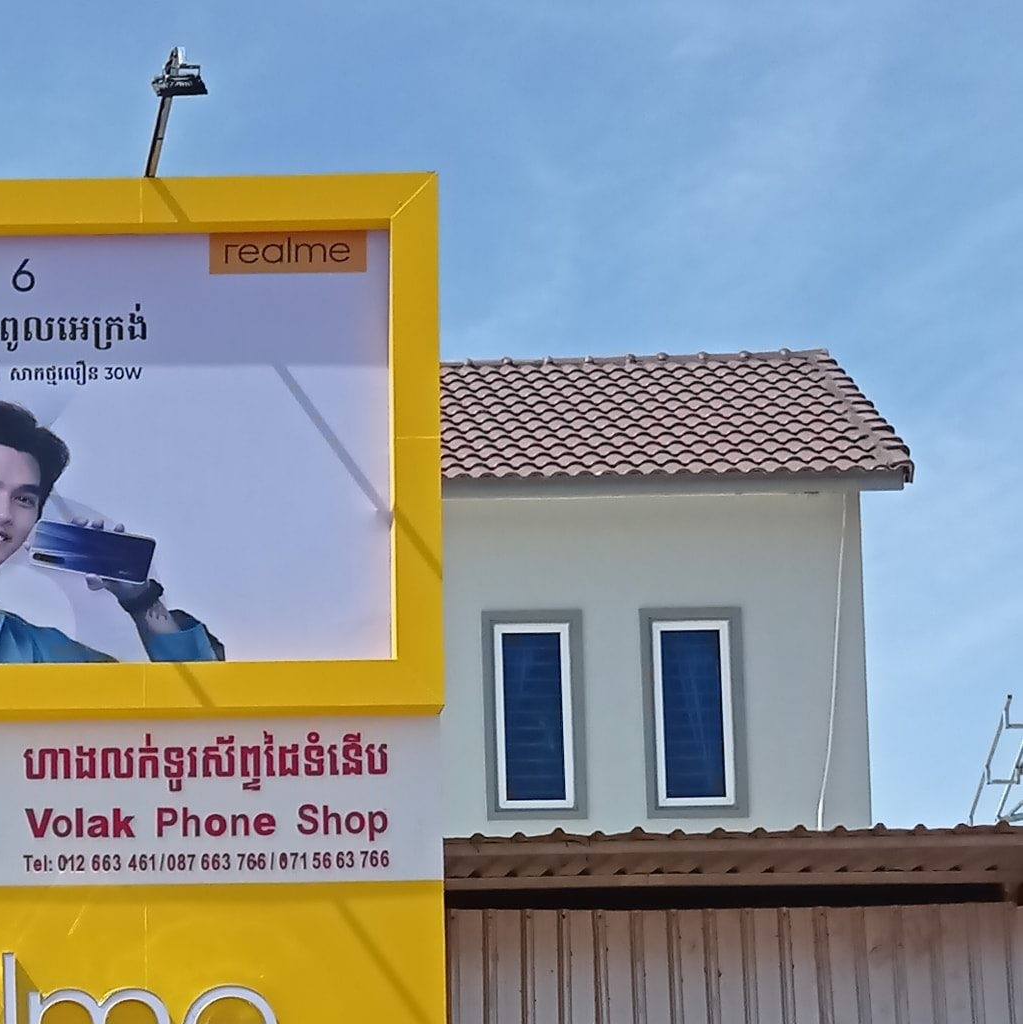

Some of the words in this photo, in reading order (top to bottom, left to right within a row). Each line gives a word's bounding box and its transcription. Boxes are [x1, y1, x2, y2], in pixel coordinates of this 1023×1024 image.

[224, 237, 351, 264] realme
[12, 258, 36, 293] 6
[104, 366, 143, 381] 30W
[24, 807, 137, 839] Volak
[155, 805, 277, 838] Phone
[296, 803, 389, 842] Shop
[23, 854, 53, 873] Tel:
[57, 854, 85, 872] 012
[91, 854, 122, 872] 663
[201, 853, 231, 871] 663
[360, 849, 390, 868] 766
